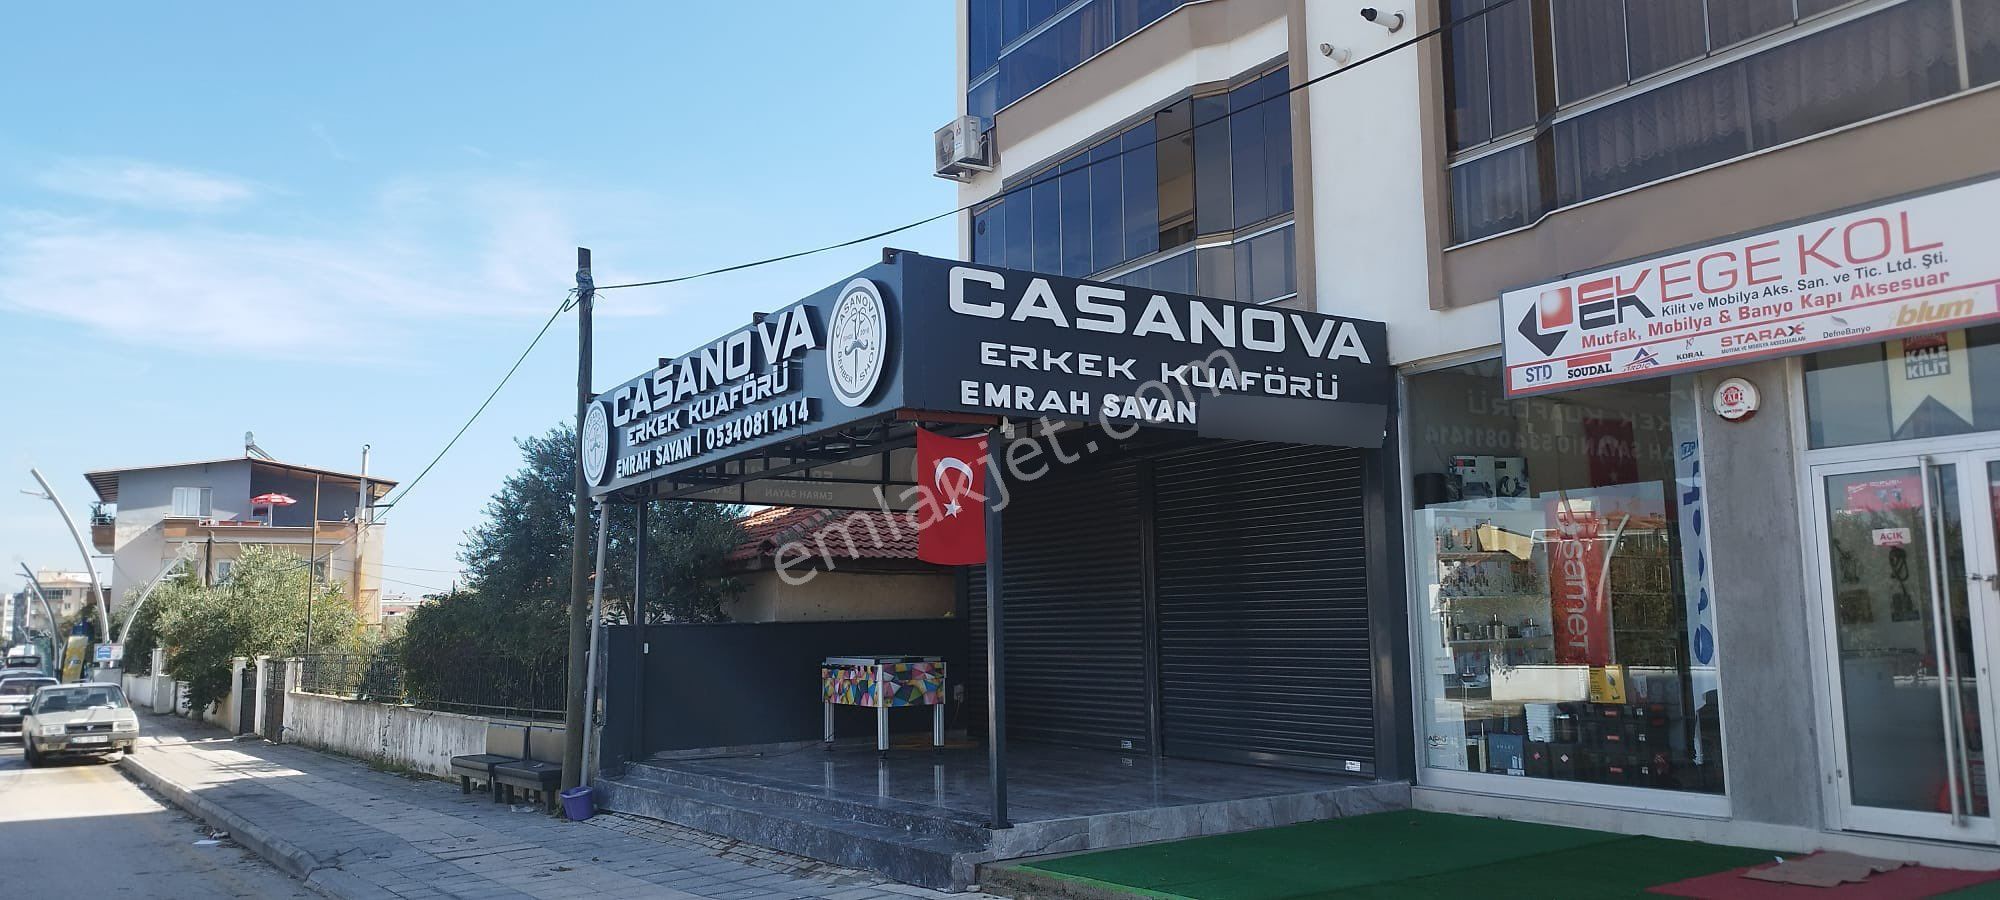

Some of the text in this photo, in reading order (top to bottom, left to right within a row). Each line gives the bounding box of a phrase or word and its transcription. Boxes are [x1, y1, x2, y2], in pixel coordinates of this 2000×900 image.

[1659, 211, 1944, 304] EGE KOL
[1661, 251, 1948, 318] Kilit ve Mobilya Aks. San. ve Tic. Ltd. Şti.
[836, 295, 877, 339] CASANOVA
[949, 266, 1372, 364] CASANOVA
[1581, 271, 1950, 349] Mutfak, Mobilya & Banyo Kapı Aksesuar
[1896, 299, 1975, 327] blum
[1721, 324, 1805, 347] STARAX
[1823, 325, 1872, 340] DefneBanyo
[1906, 345, 1948, 363] KALE
[613, 304, 816, 427] CASANOVA
[981, 342, 1338, 400] ERKEK KUAFÖRÜ
[1526, 365, 1552, 383] STD
[1567, 363, 1612, 379] SOUDAL
[1676, 351, 1705, 361] KORAL
[627, 408, 680, 447] ERKEK
[689, 360, 789, 425] KUAFÖRÜ
[961, 380, 1196, 424] EMRAH SAYAN
[616, 450, 650, 479] EMRAH
[656, 435, 692, 466] SAYAN
[706, 397, 809, 450] 05340811414
